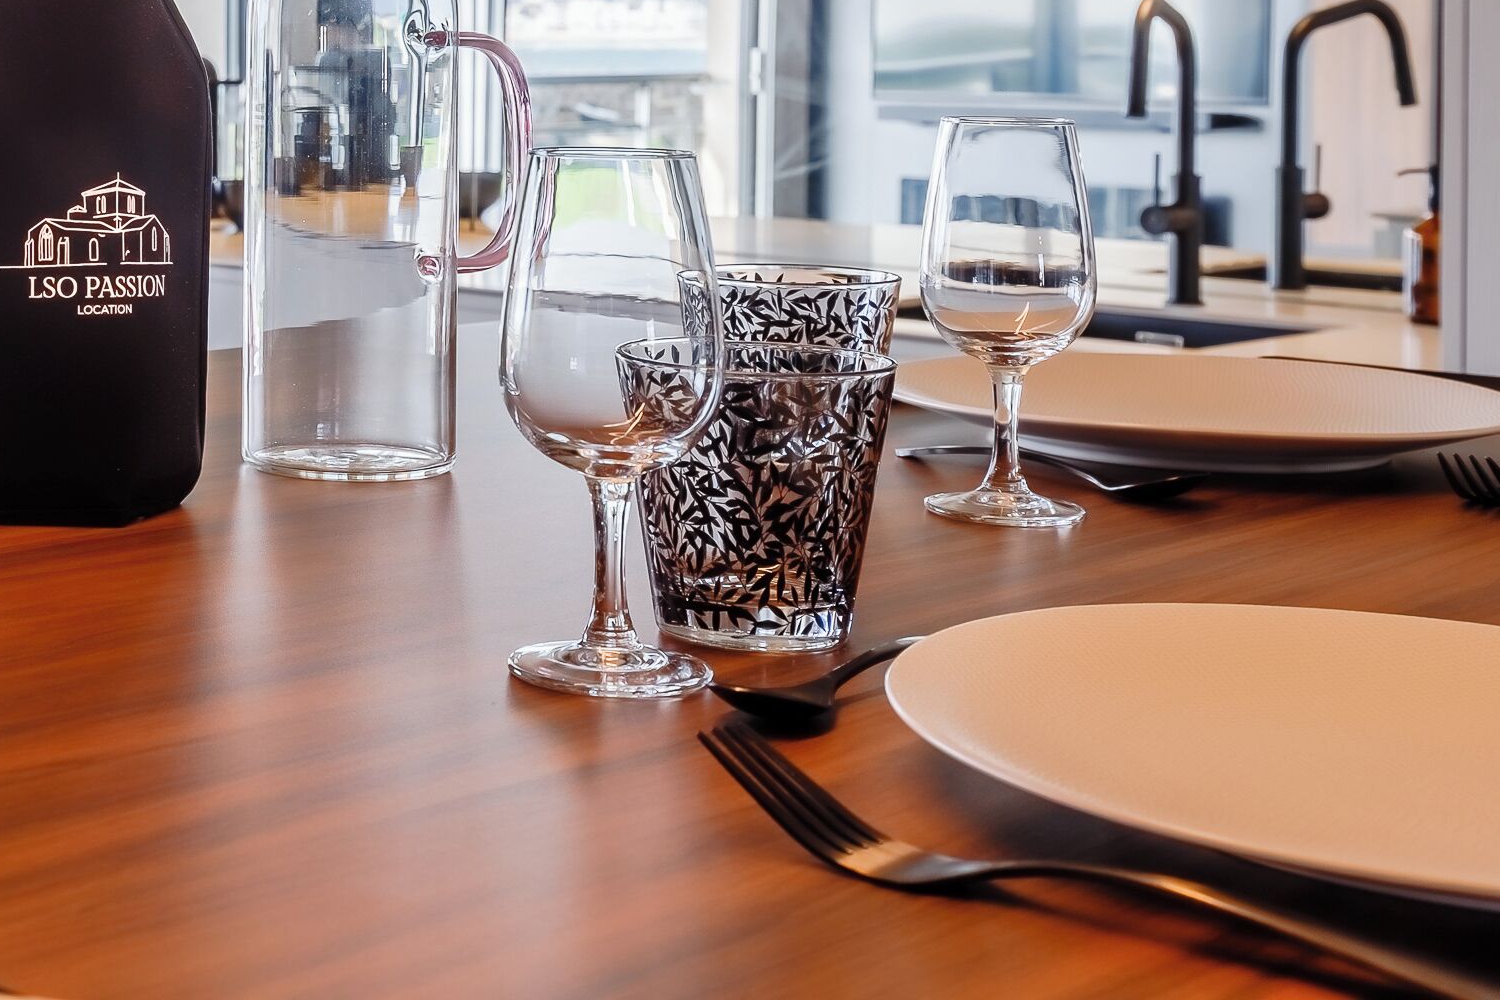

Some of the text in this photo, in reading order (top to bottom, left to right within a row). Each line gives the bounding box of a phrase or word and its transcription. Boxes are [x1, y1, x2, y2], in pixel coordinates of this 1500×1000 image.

[28, 274, 166, 299] LSO PASSION
[77, 303, 133, 315] LOCATION
